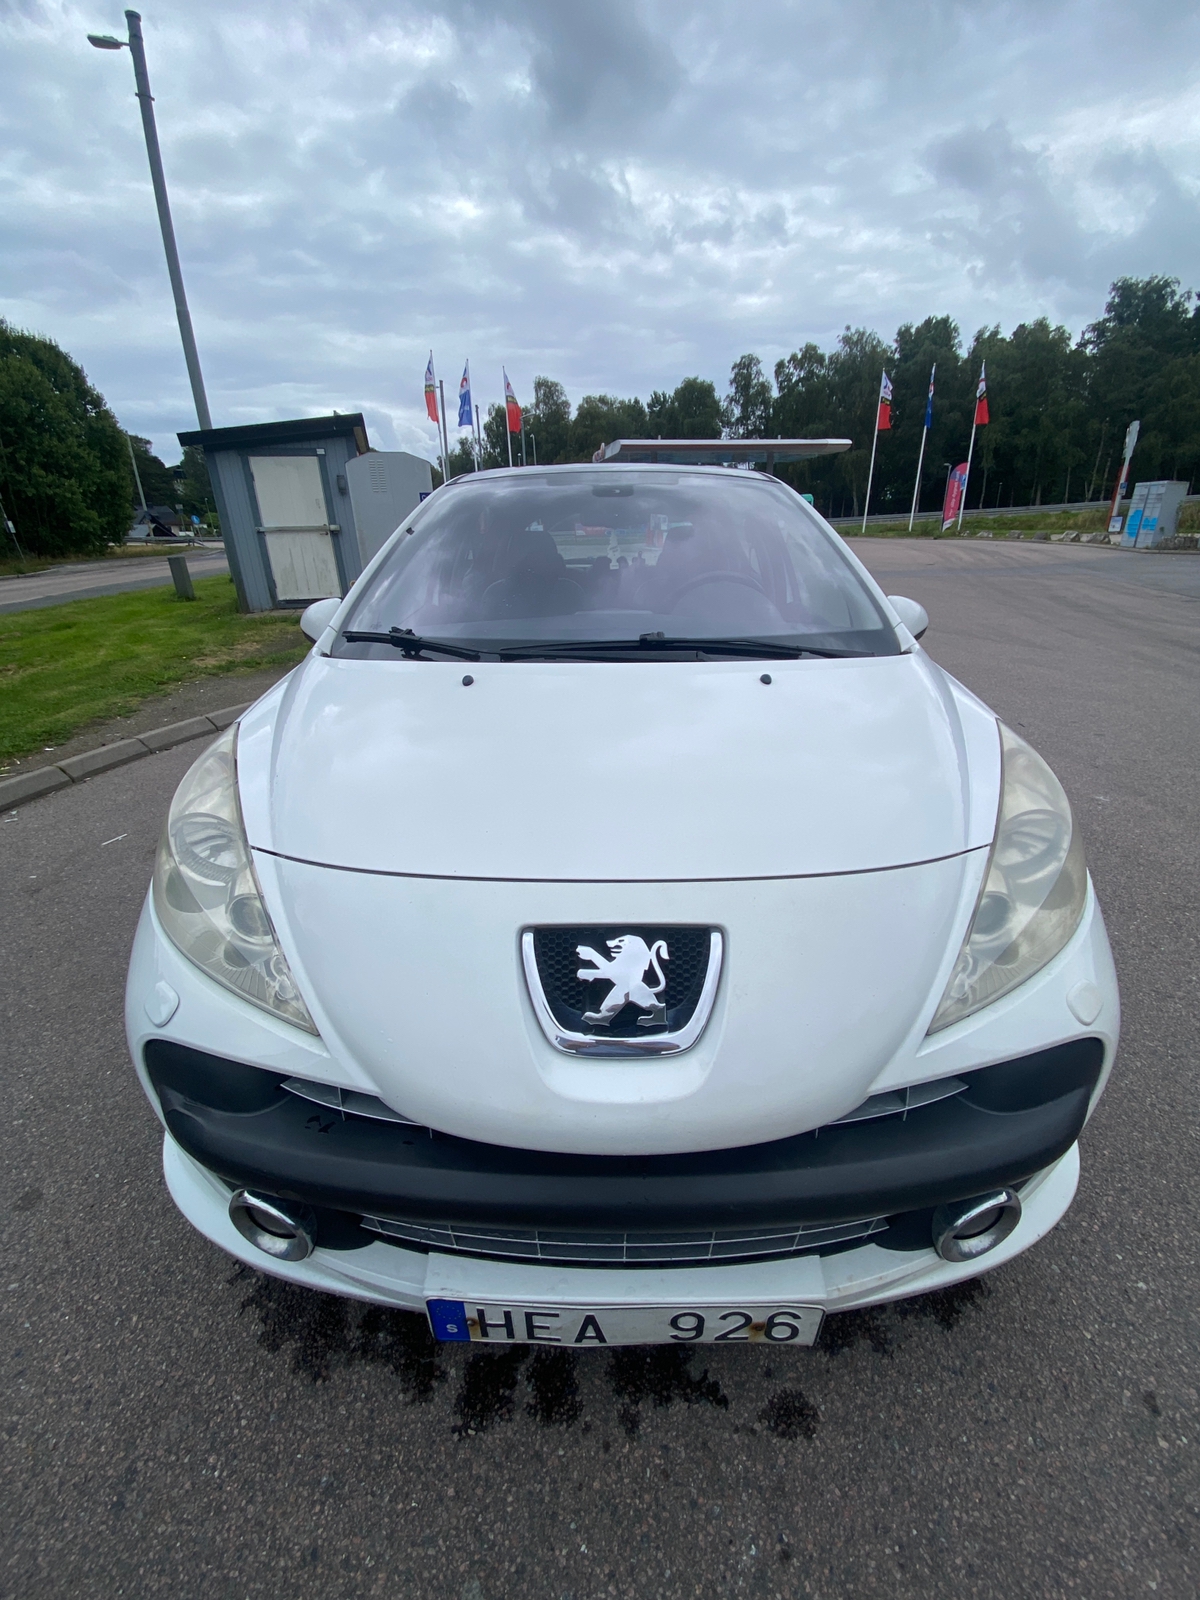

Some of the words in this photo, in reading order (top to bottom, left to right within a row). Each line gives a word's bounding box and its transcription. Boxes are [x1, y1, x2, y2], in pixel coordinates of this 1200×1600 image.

[446, 1323, 459, 1333] S
[476, 1307, 608, 1344] HEA
[669, 1310, 803, 1342] 926
